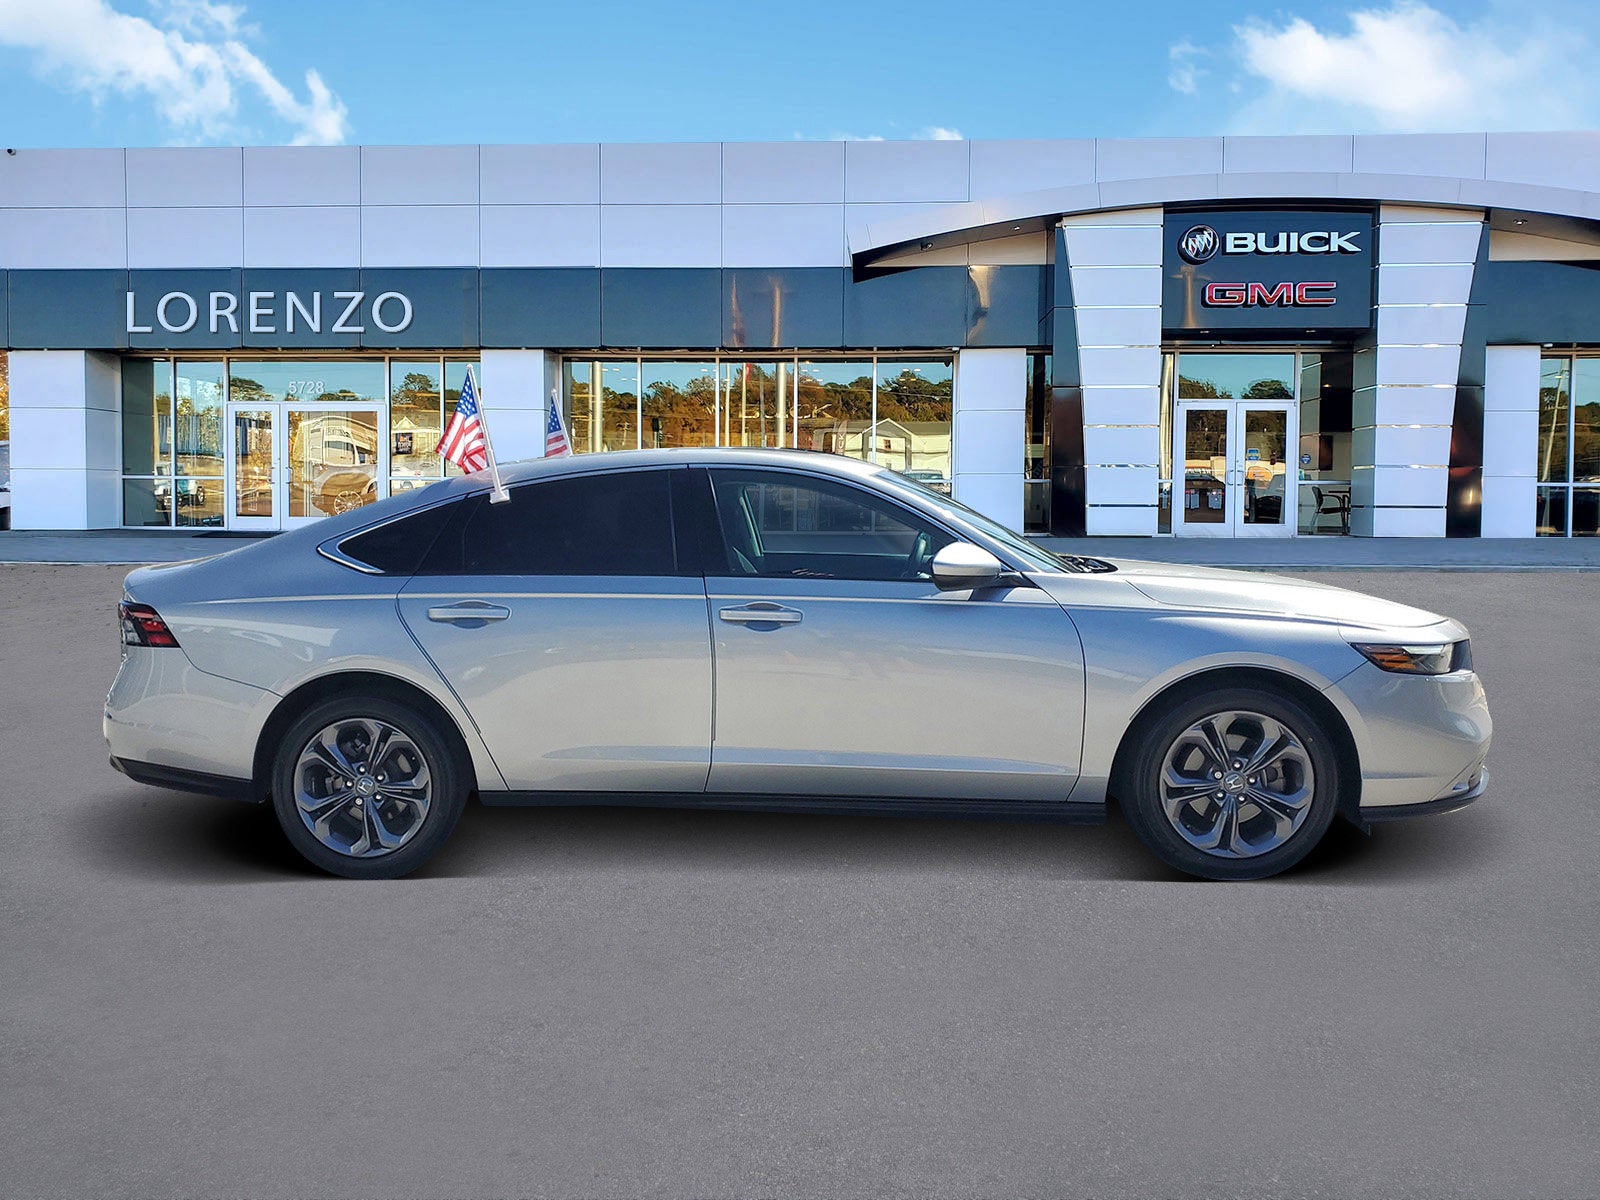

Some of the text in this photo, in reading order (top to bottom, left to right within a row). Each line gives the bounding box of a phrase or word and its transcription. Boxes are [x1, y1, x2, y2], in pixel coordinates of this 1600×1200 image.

[1225, 231, 1362, 253] BUICK
[1205, 281, 1337, 305] GMC
[126, 291, 413, 333] LORENZO
[288, 380, 325, 394] 5728
[738, 403, 834, 419] BUCK
